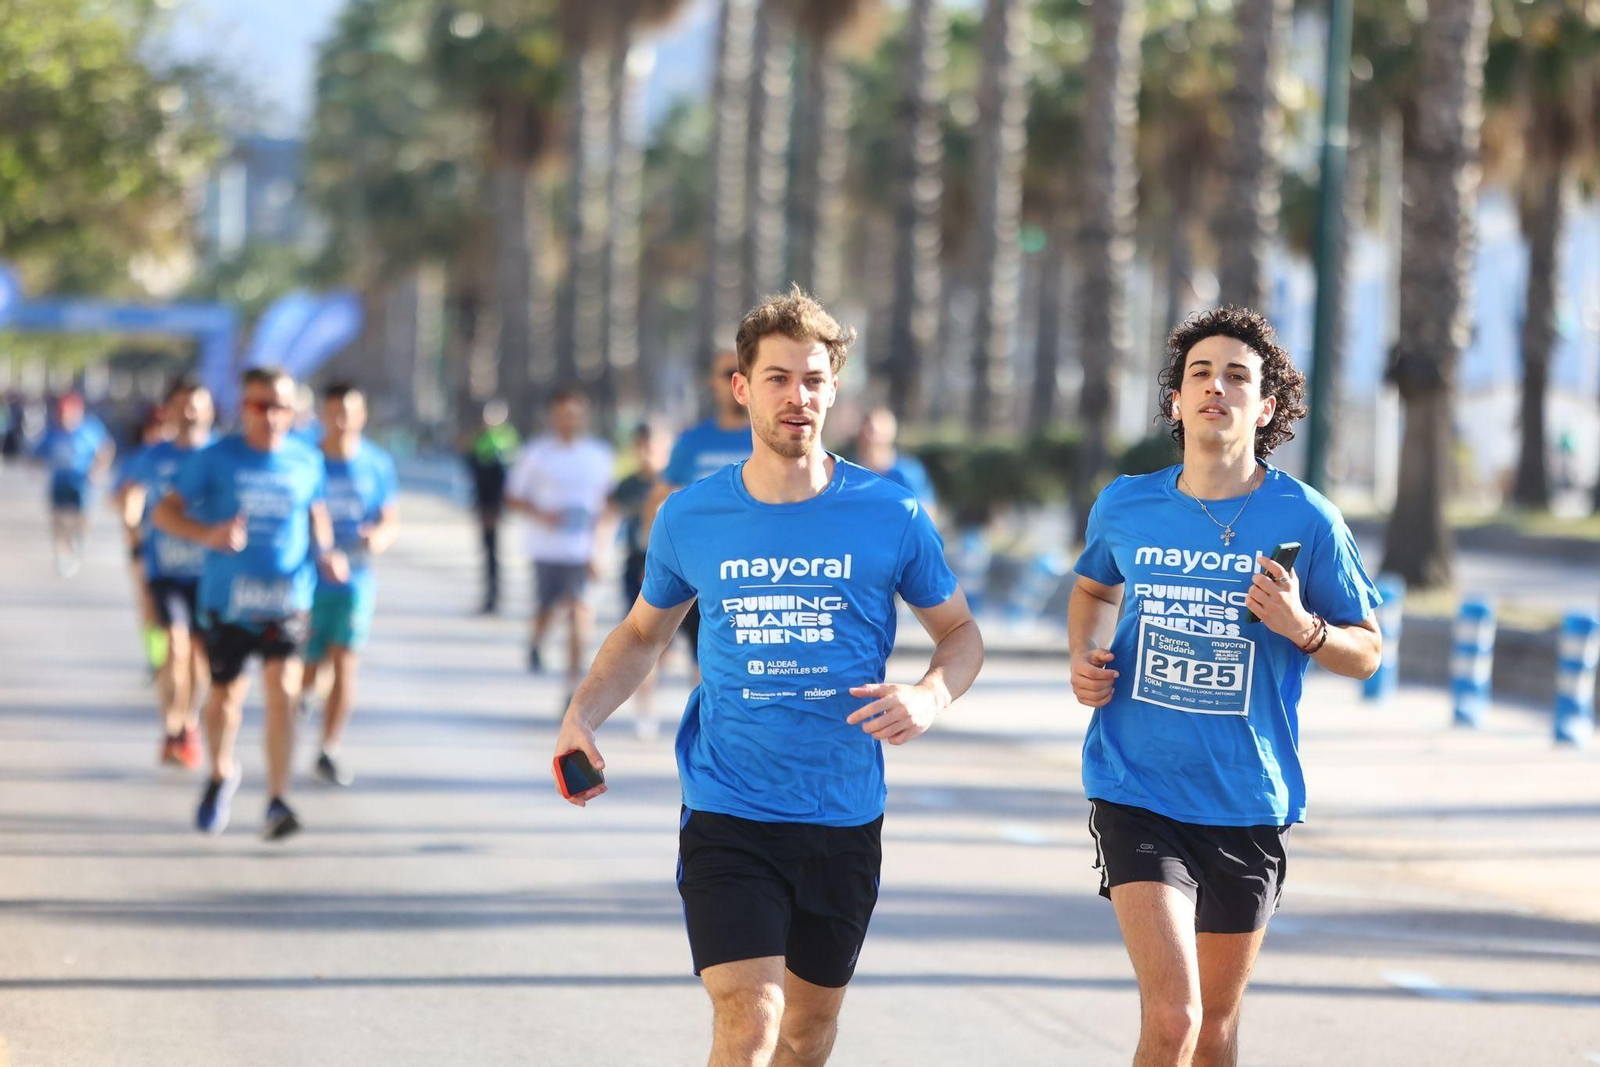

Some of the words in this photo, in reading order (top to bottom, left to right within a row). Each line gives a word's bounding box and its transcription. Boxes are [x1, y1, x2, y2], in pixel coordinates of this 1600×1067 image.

[1135, 547, 1263, 573] mayoral
[720, 554, 852, 583] mayoral
[1134, 583, 1249, 606] RUNNING
[722, 595, 842, 613] RUNNING
[1143, 600, 1239, 620] MAKES
[736, 612, 832, 627] MAKES
[735, 628, 835, 644] FRIENDS
[1159, 634, 1190, 647] Carrera
[1158, 641, 1195, 656] Solidaria
[1211, 641, 1247, 649] mayoral
[766, 660, 798, 668] ALDEAS
[767, 667, 811, 675] INFANTILES
[811, 666, 829, 674] SOS
[1151, 654, 1236, 687] 2125
[1144, 676, 1163, 687] 10KM
[804, 688, 836, 698] málaga
